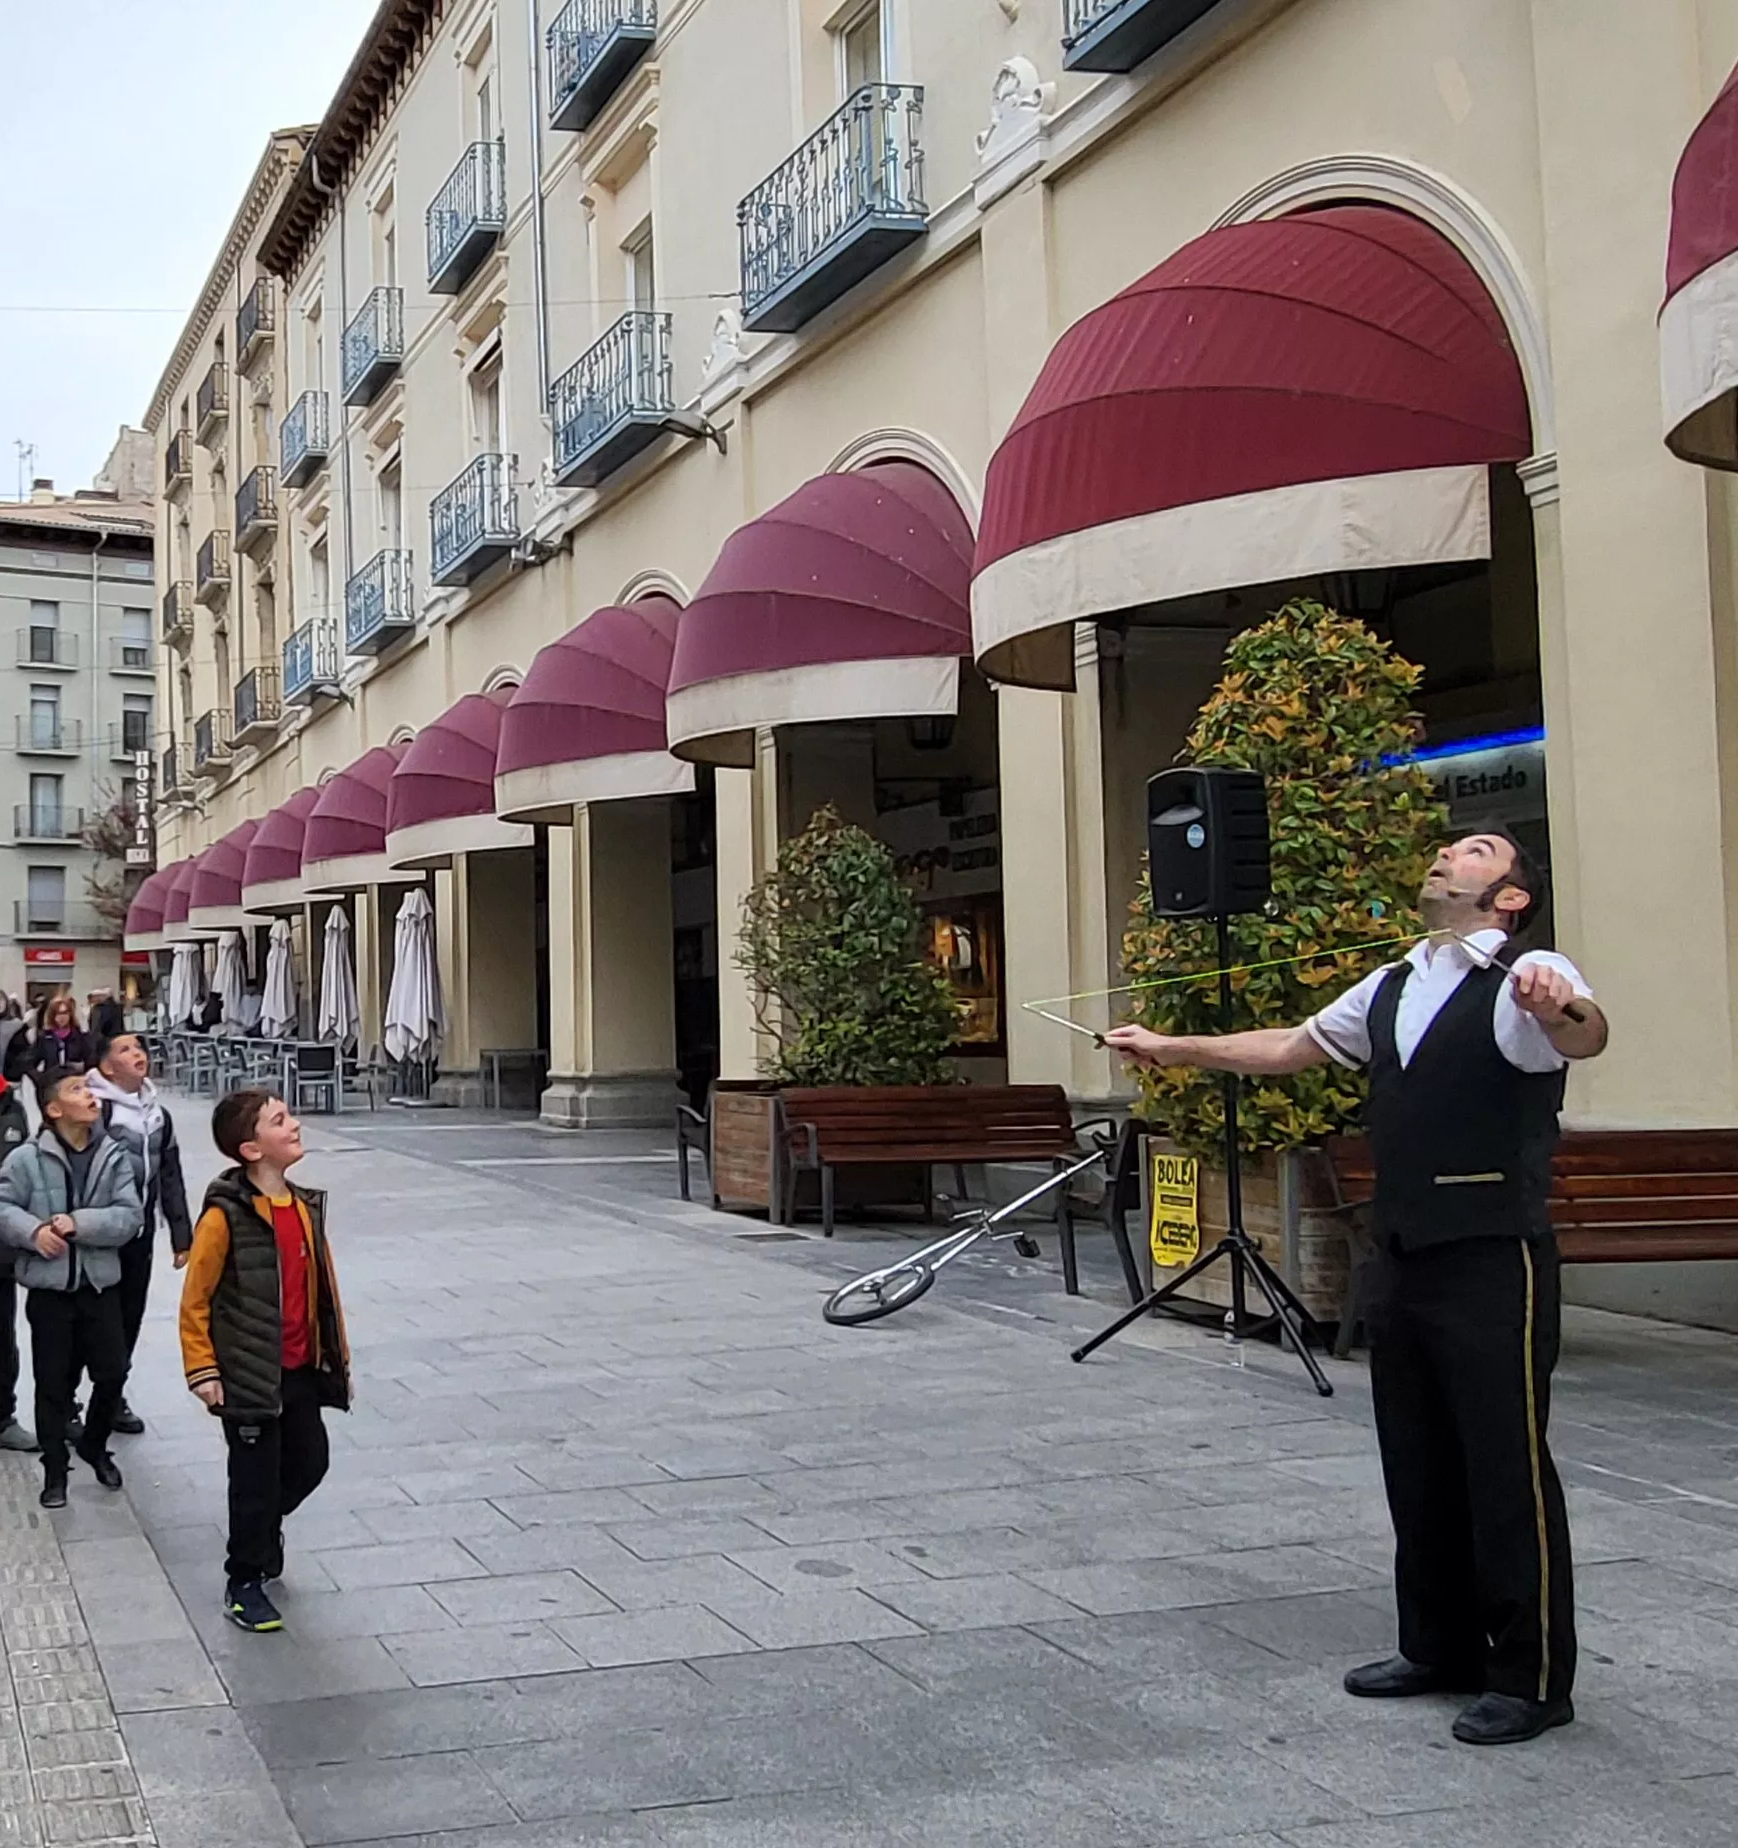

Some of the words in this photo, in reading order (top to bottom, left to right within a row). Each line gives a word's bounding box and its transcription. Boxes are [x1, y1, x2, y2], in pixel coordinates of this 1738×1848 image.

[135, 750, 150, 845] HOSTAL
[1456, 764, 1527, 798] Estado
[1158, 1158, 1195, 1186] BOLEA
